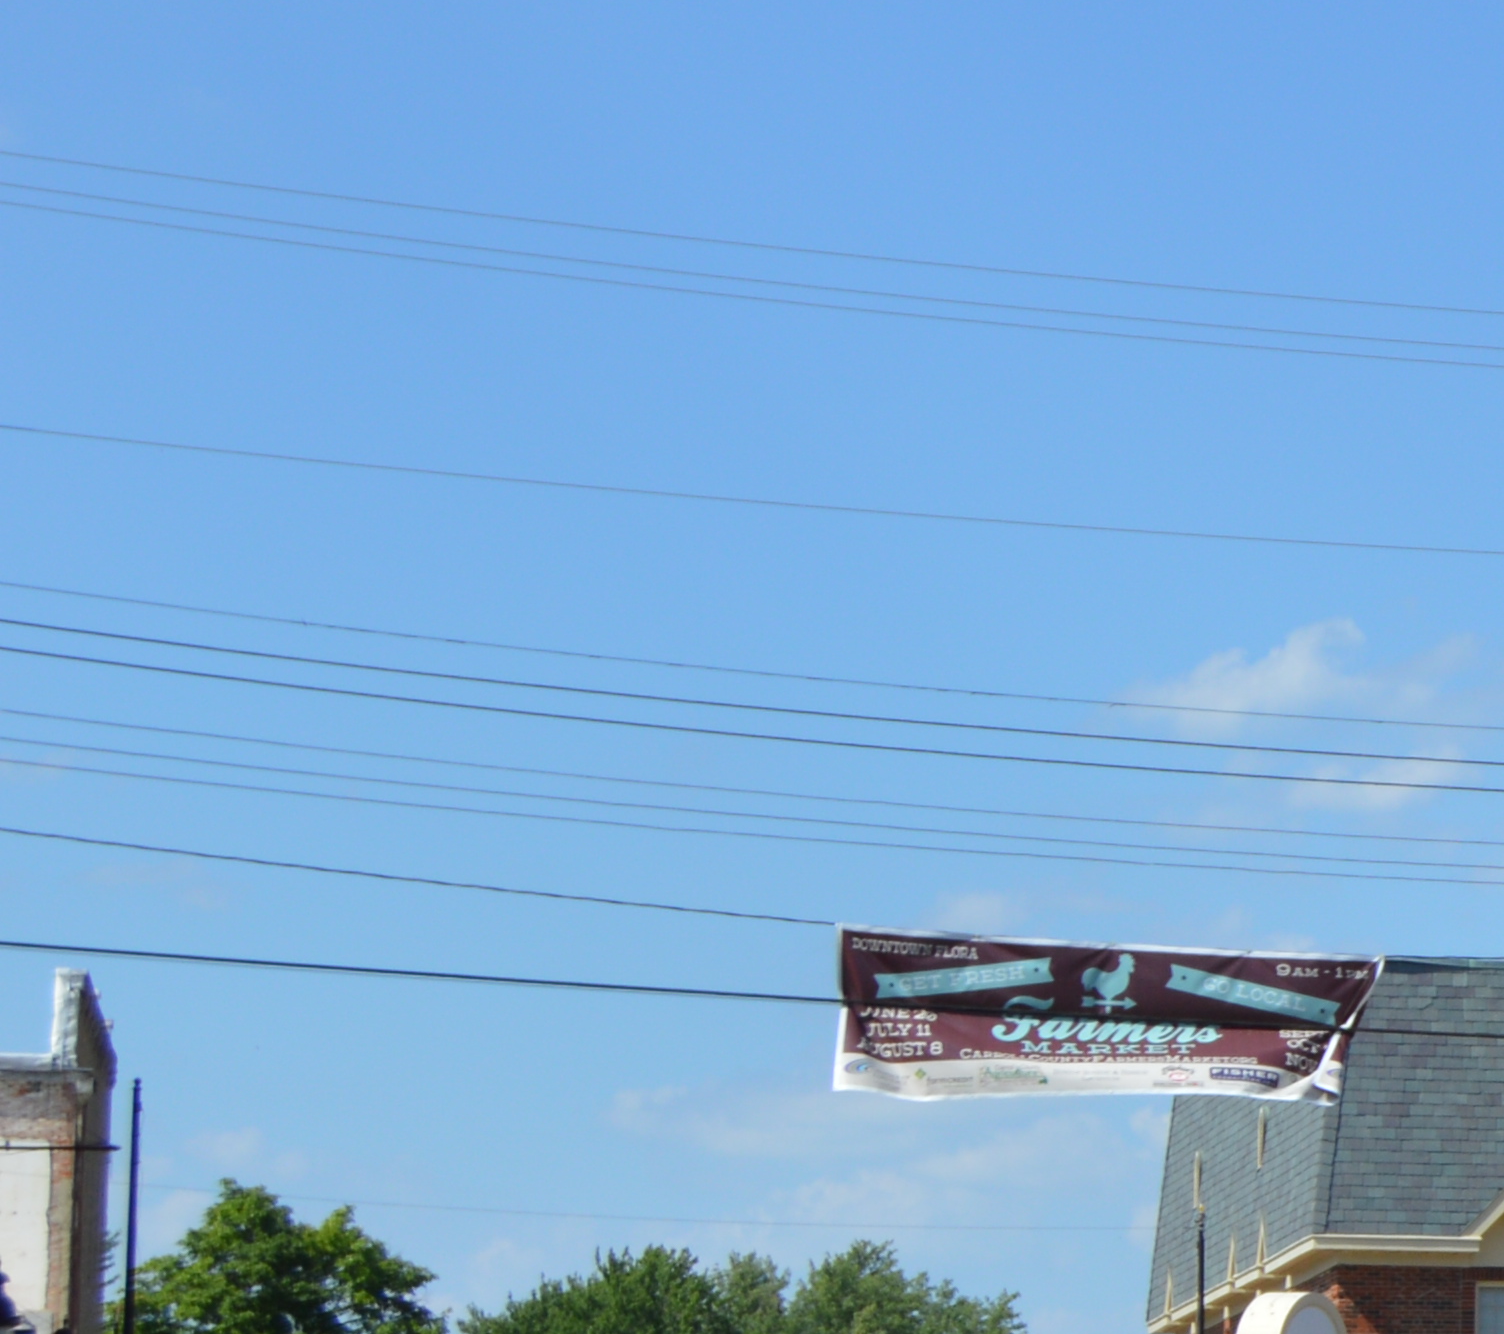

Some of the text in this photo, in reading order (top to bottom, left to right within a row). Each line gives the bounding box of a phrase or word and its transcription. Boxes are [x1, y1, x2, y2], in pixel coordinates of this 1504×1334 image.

[851, 937, 979, 960] DOWNTOWN FLORA
[898, 965, 1025, 992] GET FRESH
[1202, 977, 1306, 1012] GO LOCAL
[866, 1022, 932, 1038] JULY 11
[991, 995, 1223, 1044] Farmers
[856, 1037, 944, 1058] AUGUST 8
[1020, 1040, 1197, 1055] MARKET
[1211, 1068, 1279, 1080] FISHER
